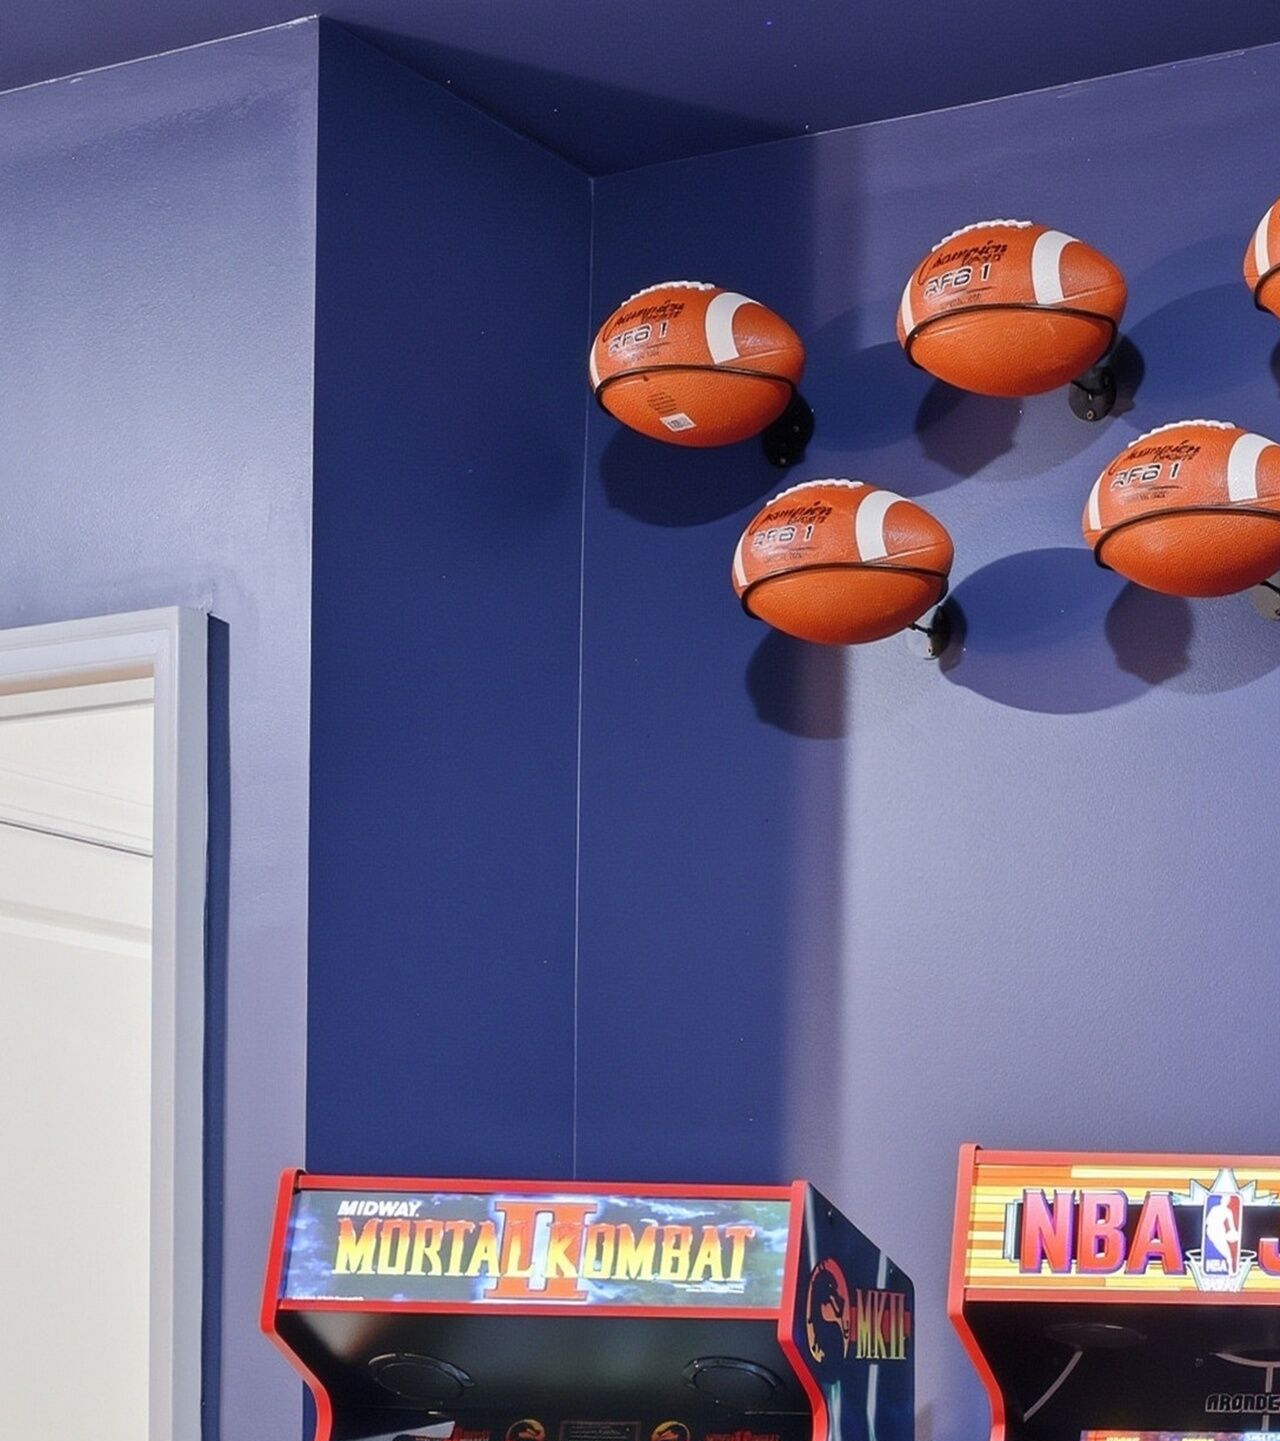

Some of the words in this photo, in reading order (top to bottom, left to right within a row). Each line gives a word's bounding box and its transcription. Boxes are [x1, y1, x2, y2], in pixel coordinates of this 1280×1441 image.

[331, 1217, 533, 1278] MORTAL
[546, 1222, 756, 1282] KOMBAT
[1020, 1188, 1185, 1275] NBA
[855, 1288, 906, 1360] MKII
